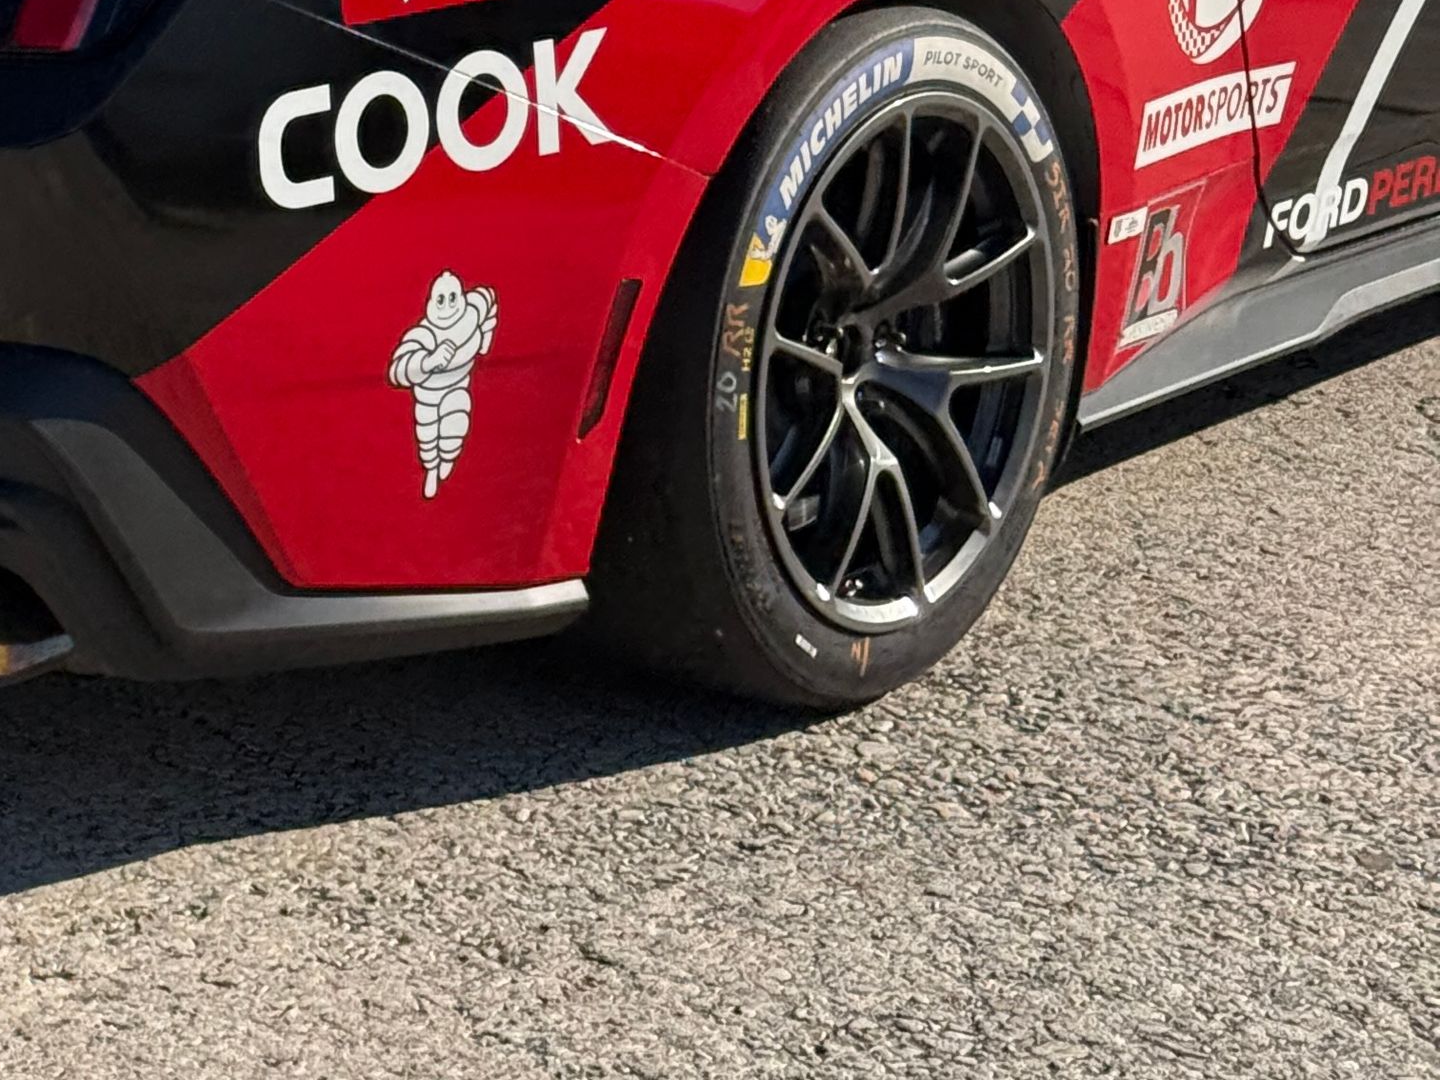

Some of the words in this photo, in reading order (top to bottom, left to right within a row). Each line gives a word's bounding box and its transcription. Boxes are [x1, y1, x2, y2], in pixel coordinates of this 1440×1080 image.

[258, 26, 611, 210] COOK
[779, 51, 904, 210] MICHELIN
[923, 50, 962, 67] PILOT
[962, 56, 1004, 88] SPORT
[1142, 73, 1294, 153] MOTORSPORTS
[1365, 155, 1440, 216] PER
